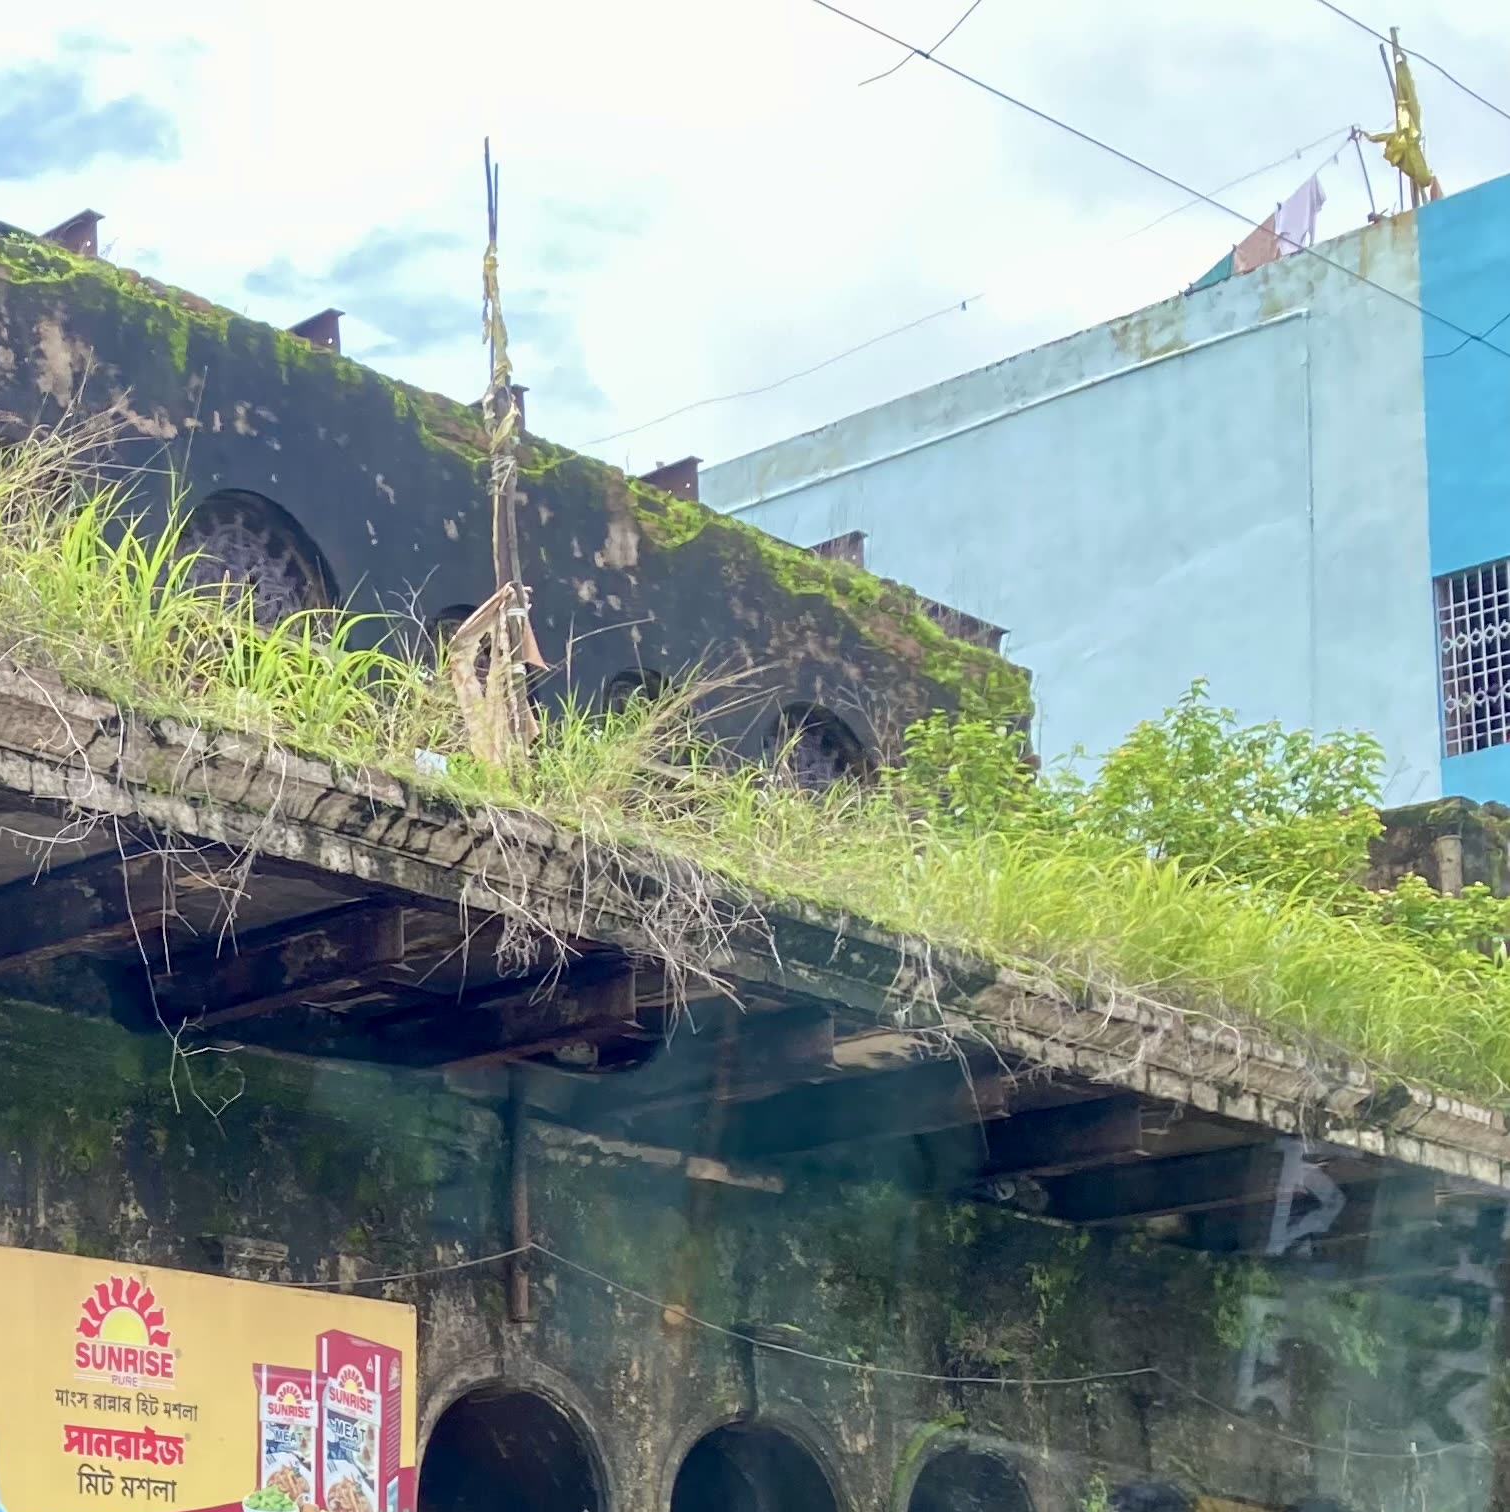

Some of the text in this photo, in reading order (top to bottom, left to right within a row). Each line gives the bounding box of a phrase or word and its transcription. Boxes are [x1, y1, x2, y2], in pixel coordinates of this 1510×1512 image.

[75, 1342, 174, 1378] SUNRISE
[111, 1375, 139, 1387] PURE
[55, 1388, 198, 1422] মাংস রান্নার হিট মশলা
[267, 1403, 311, 1419] SUNRISE
[329, 1386, 374, 1414] SUNRISE
[63, 1424, 185, 1466] সানরাইজ
[275, 1431, 303, 1442] MEAT
[335, 1421, 366, 1442] MEAT
[77, 1463, 177, 1503] মিট মশলা
